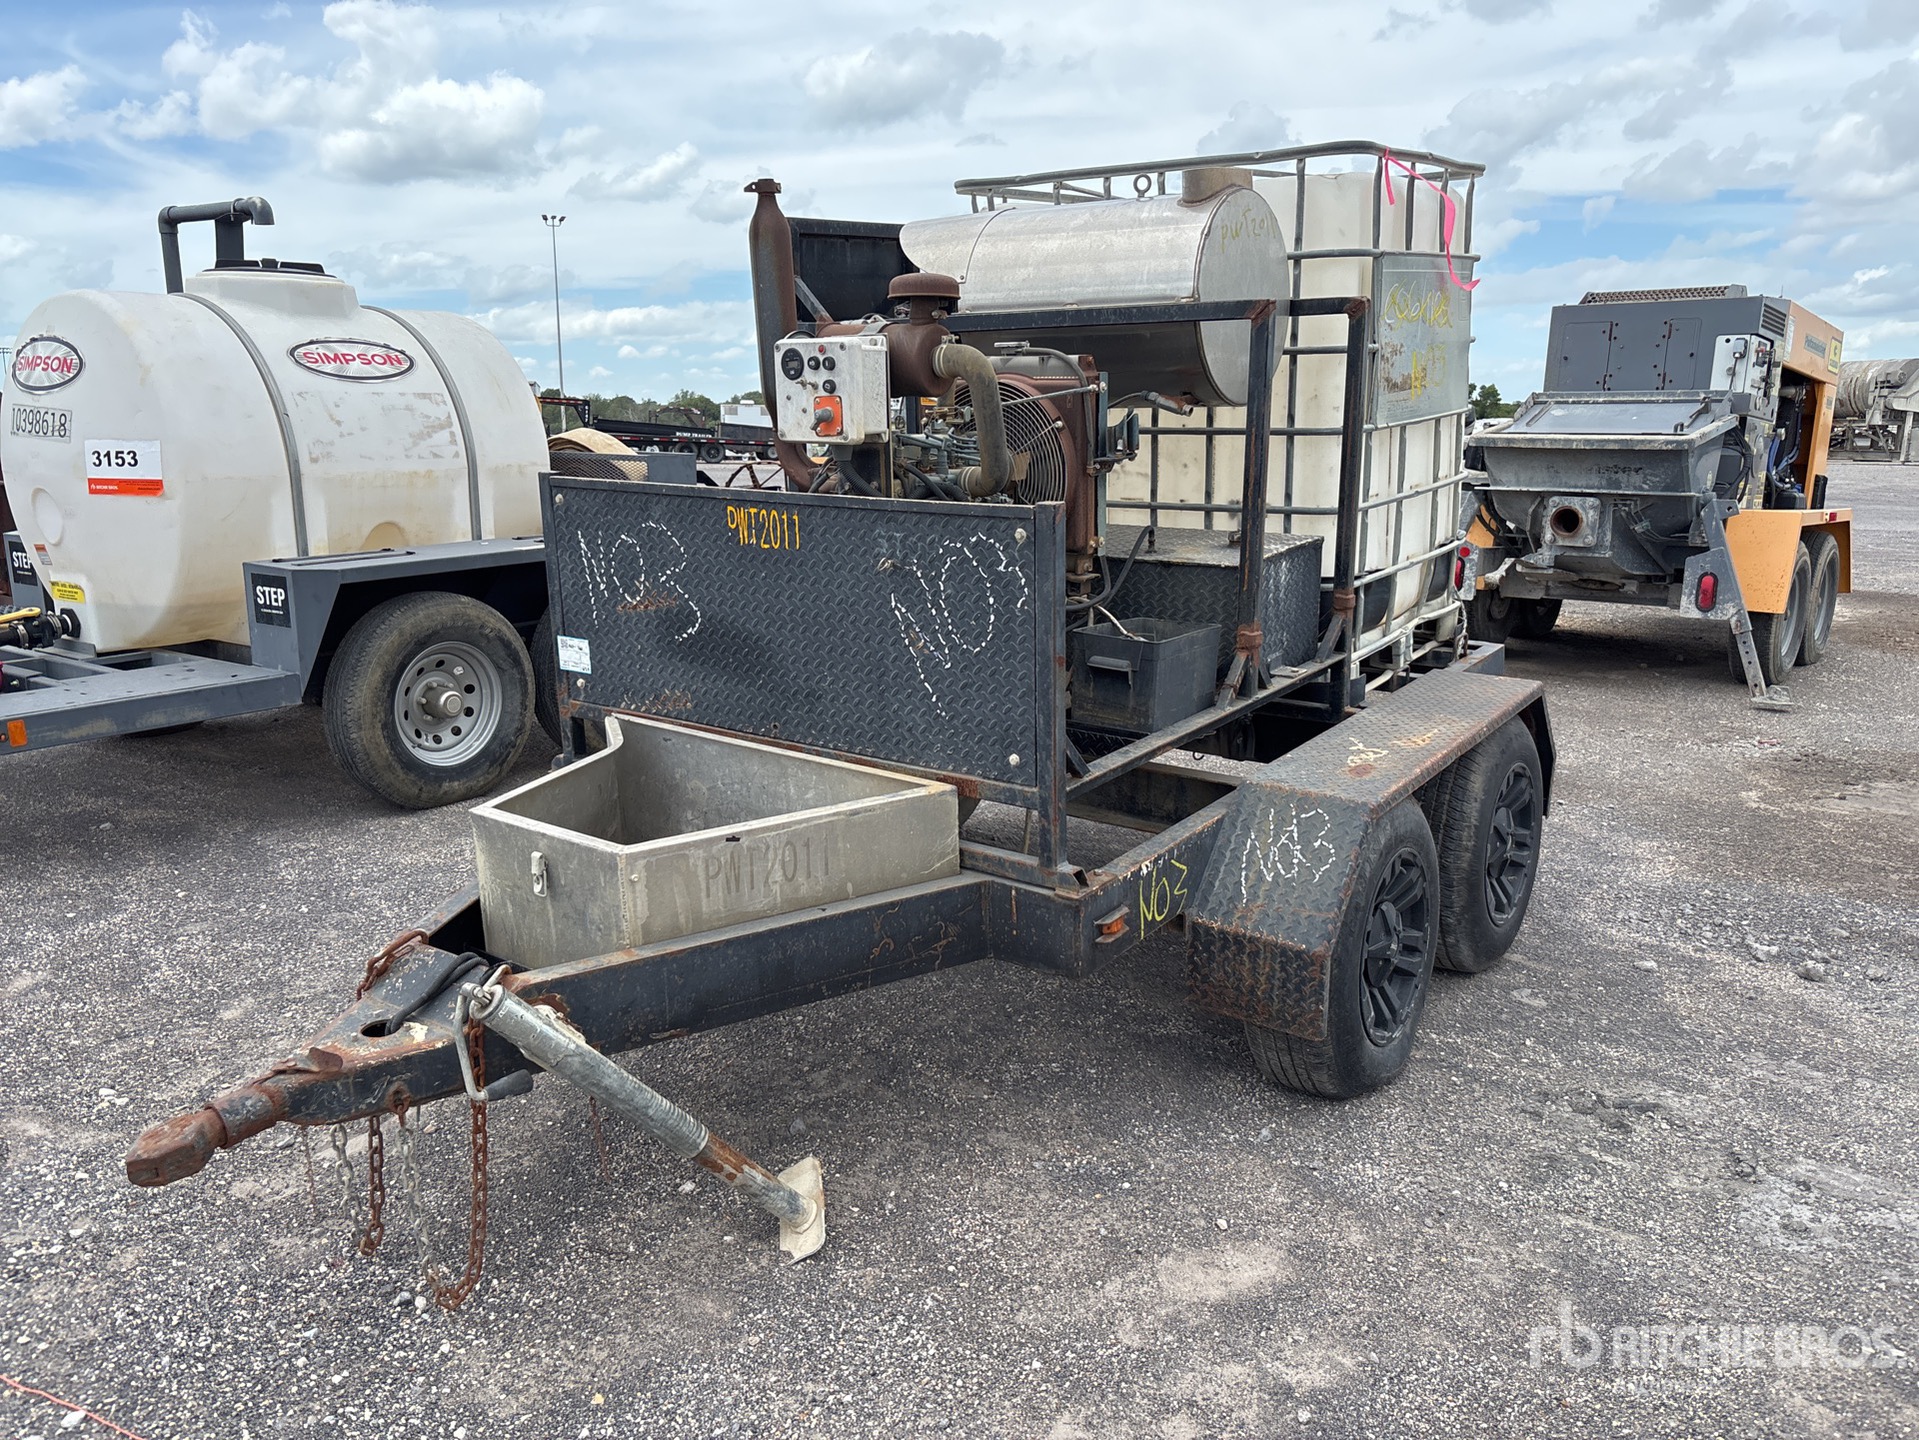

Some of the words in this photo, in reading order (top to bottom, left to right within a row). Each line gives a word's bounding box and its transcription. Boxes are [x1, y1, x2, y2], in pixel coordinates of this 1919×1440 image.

[17, 355, 74, 374] SIMPSON
[302, 351, 404, 366] SIMPSON
[12, 407, 67, 438] 10398618
[91, 450, 139, 468] 3153
[727, 505, 800, 550] PWT2011
[256, 585, 286, 607] STEP
[704, 837, 829, 898] PWT2011
[1139, 859, 1188, 939] NO3
